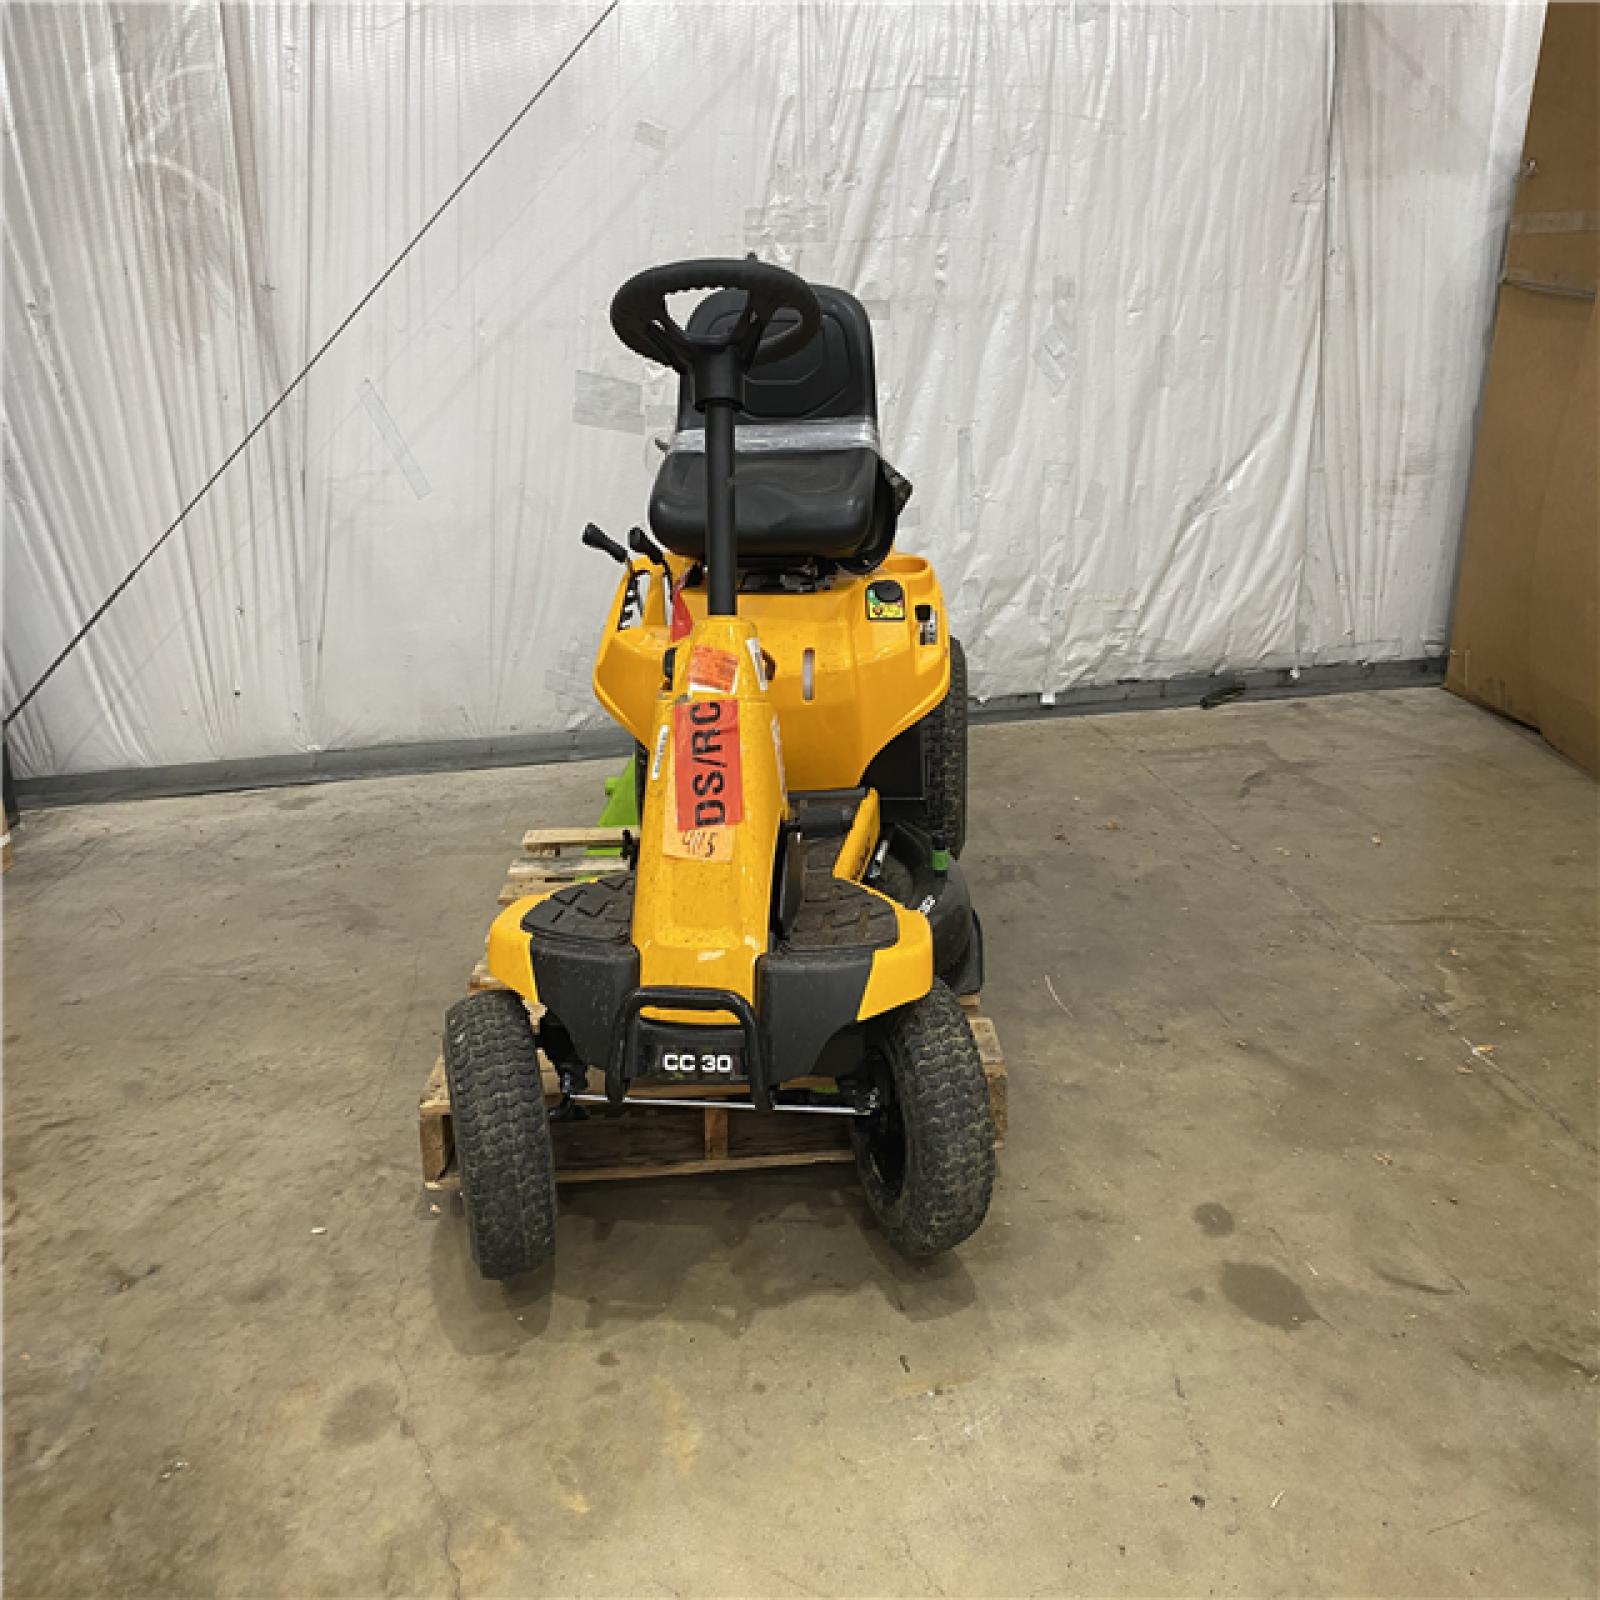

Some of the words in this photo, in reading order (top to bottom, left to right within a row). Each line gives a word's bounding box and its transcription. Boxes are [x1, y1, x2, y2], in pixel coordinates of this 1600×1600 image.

[690, 701, 728, 828] DS/RC
[664, 1054, 696, 1072] CC
[701, 1054, 732, 1073] 30
